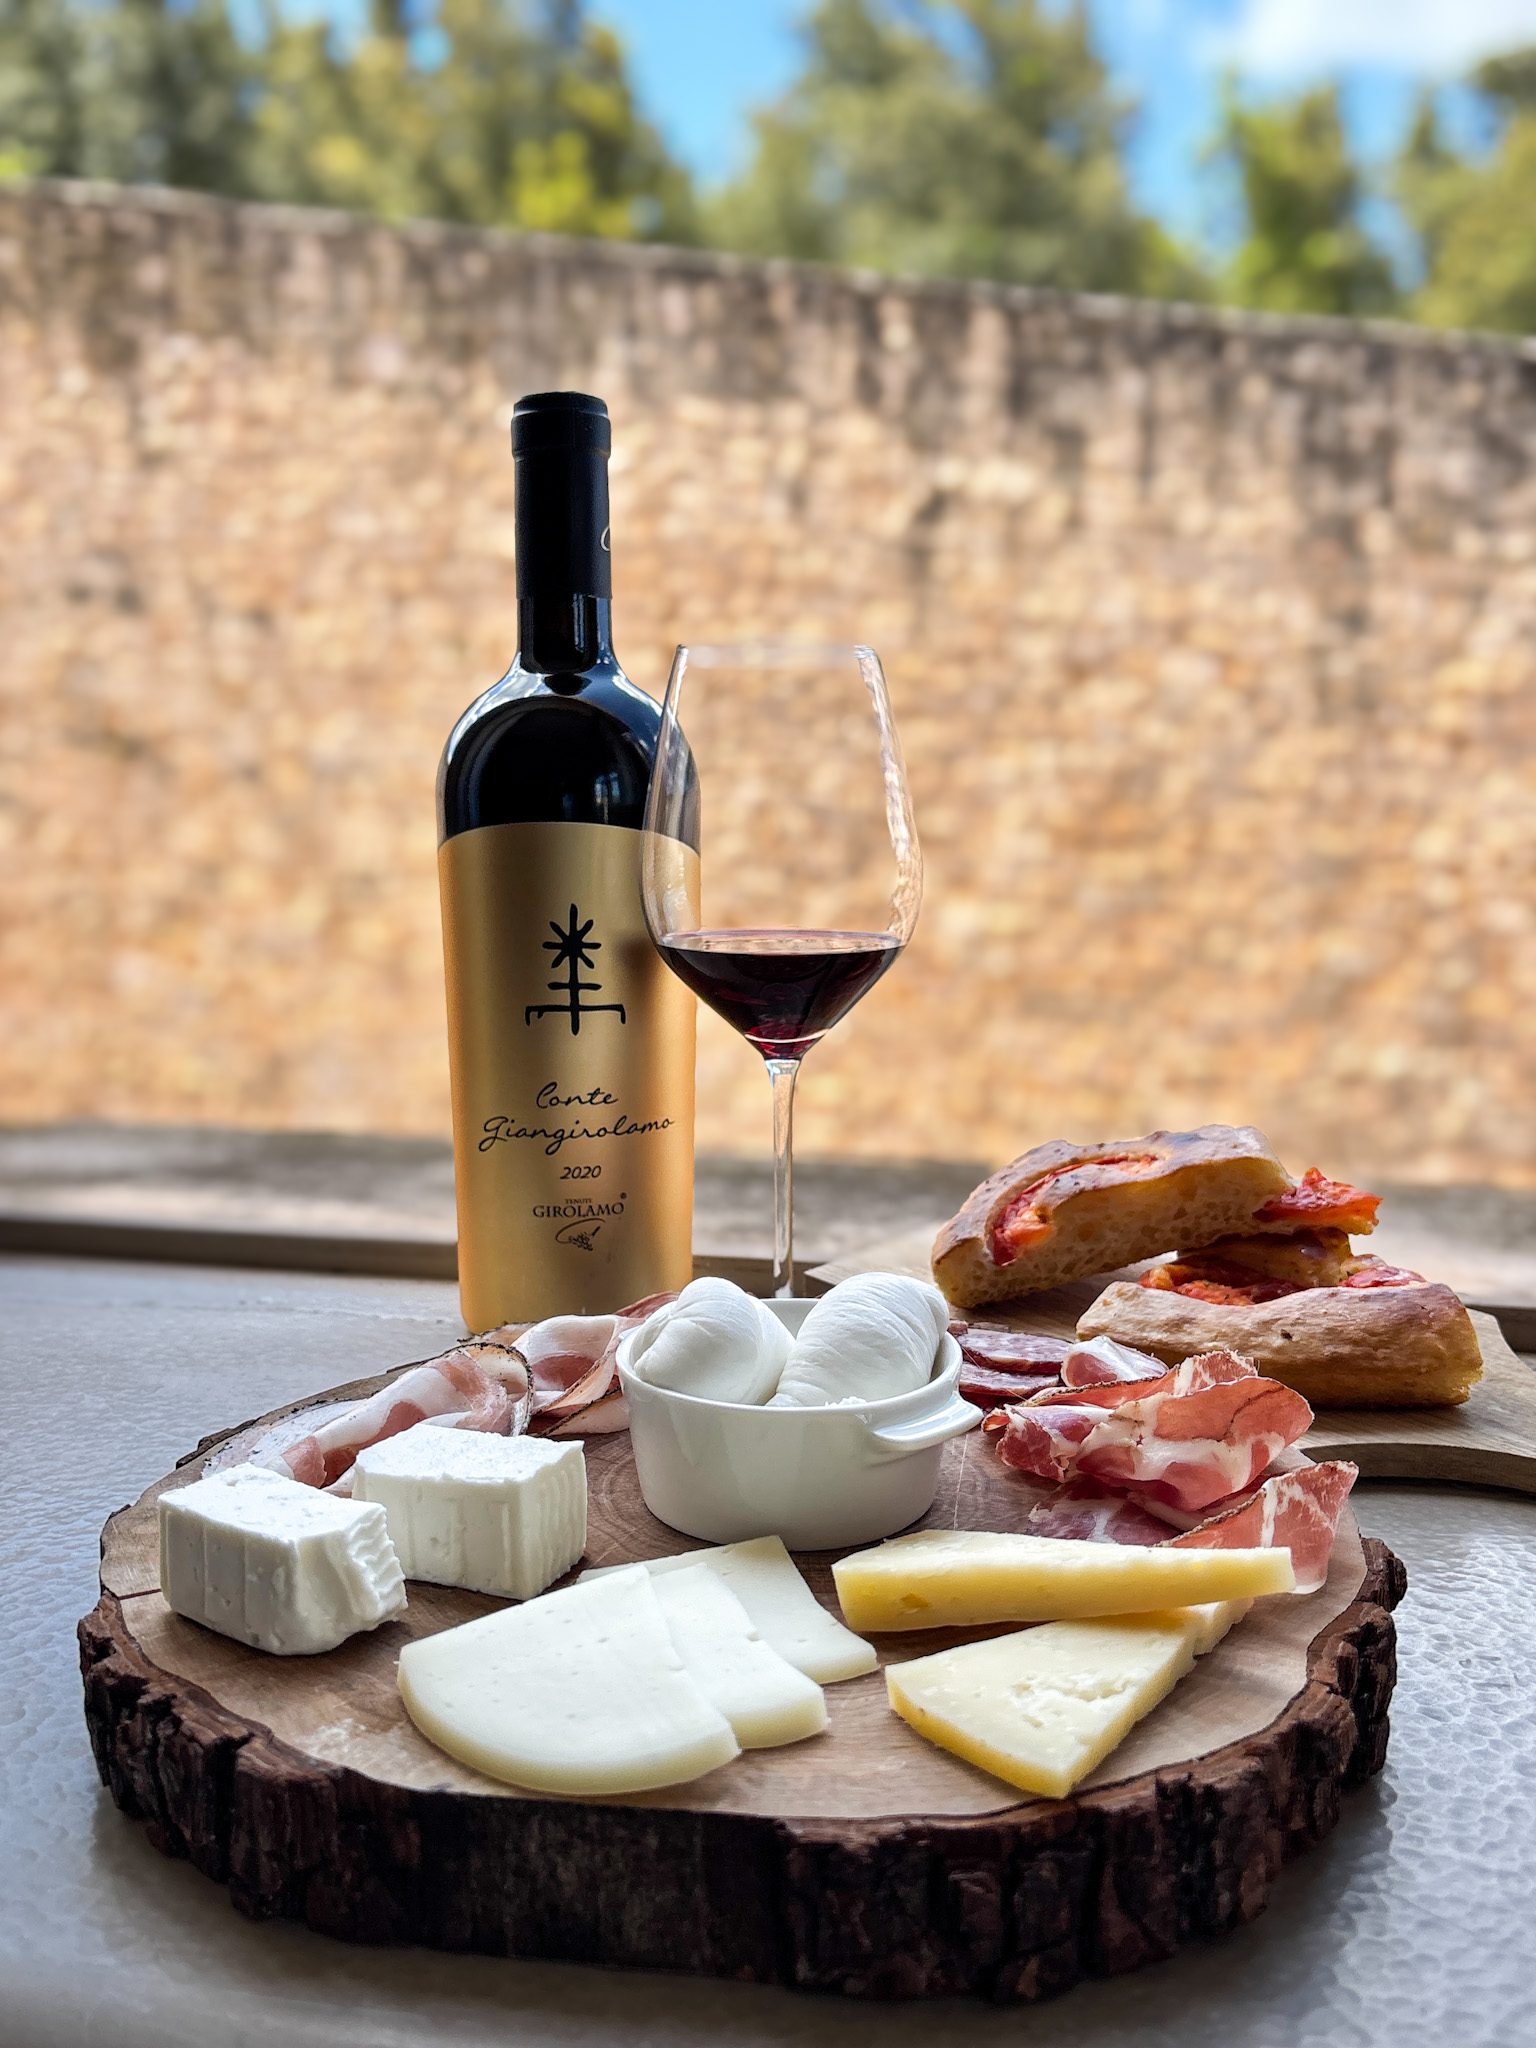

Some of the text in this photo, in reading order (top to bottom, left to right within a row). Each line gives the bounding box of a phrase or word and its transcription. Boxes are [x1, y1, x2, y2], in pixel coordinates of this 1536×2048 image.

[536, 1081, 620, 1109] Conte
[478, 1115, 676, 1156] Giangirolamo
[559, 1165, 602, 1180] 2020
[532, 1202, 625, 1218] GIROLAMO
